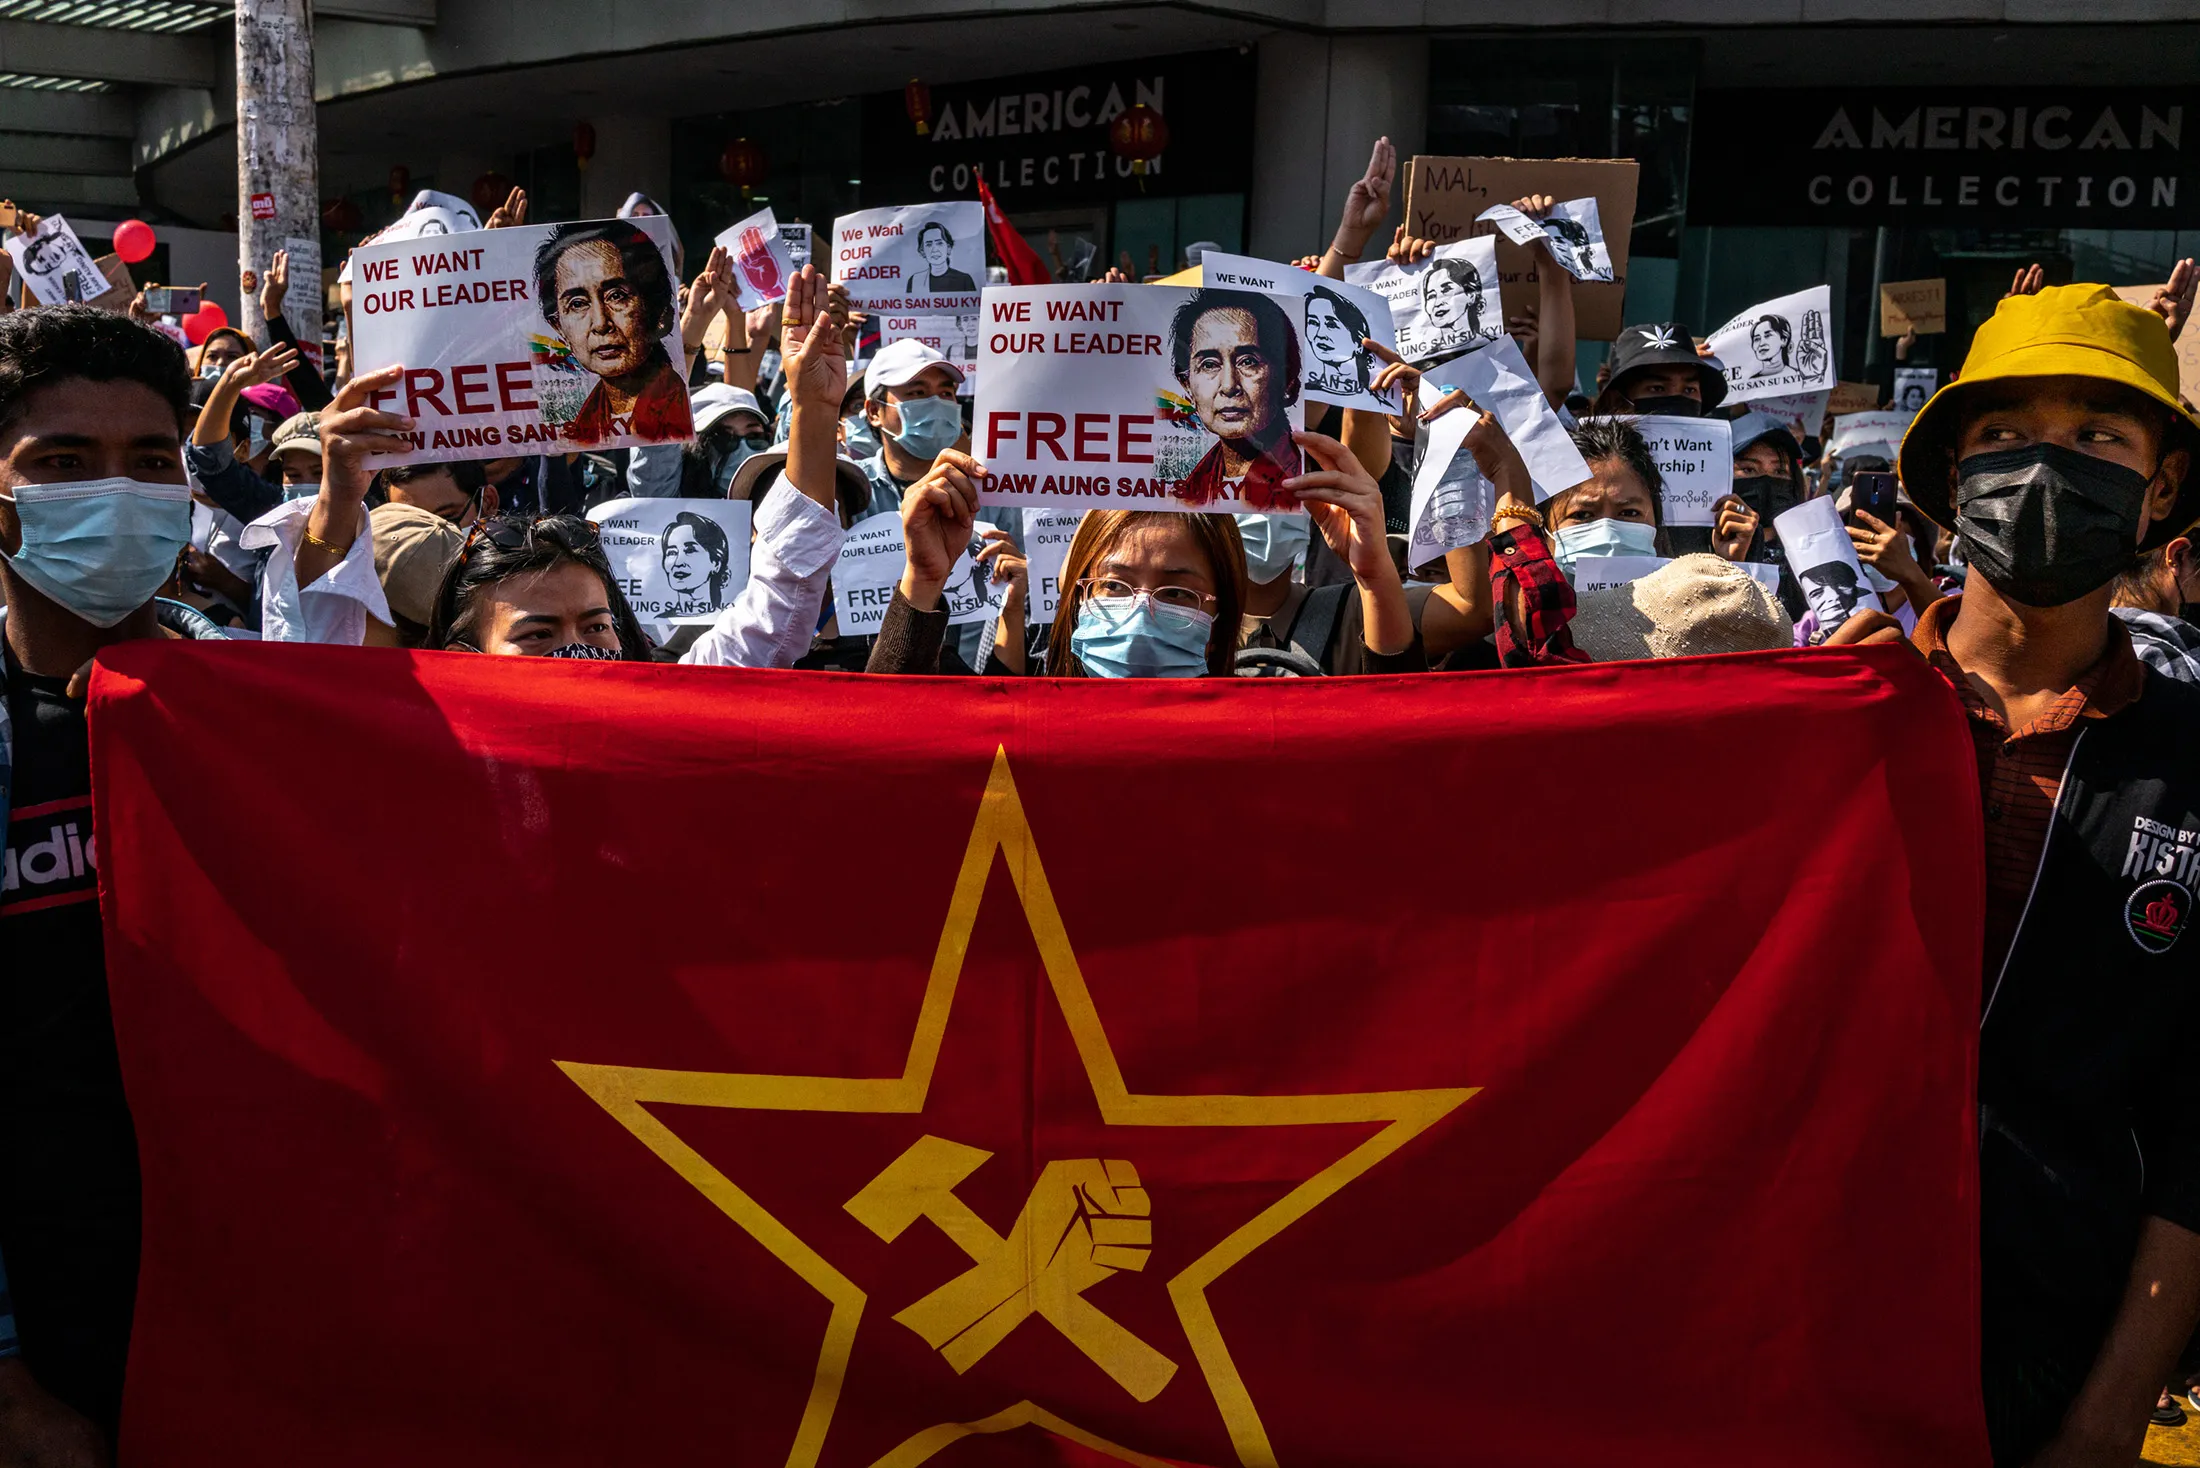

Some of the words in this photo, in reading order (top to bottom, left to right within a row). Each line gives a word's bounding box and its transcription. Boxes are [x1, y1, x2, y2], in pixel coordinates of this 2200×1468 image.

[932, 76, 1165, 142] AMERICAN
[1812, 105, 2184, 151] AMERICAN
[1425, 166, 1487, 197] MAL,
[1808, 175, 2178, 208] COLLECTION
[842, 229, 863, 242] We
[868, 223, 904, 239] Want
[1418, 210, 1464, 239] Your
[840, 247, 872, 261] OUR
[363, 259, 399, 283] WE
[412, 248, 485, 276] WANT
[839, 266, 901, 281] LEADER
[1216, 272, 1237, 285] WE
[1239, 276, 1275, 290] WANT
[1376, 278, 1404, 290] WANT
[364, 289, 415, 315] OUR
[423, 279, 529, 308] LEADER
[1387, 288, 1419, 302] EADER
[868, 299, 902, 310] AUNG
[905, 299, 931, 309] SAN
[934, 298, 958, 308] SUU
[992, 302, 1031, 323] WE
[1046, 301, 1124, 322] WANT
[888, 319, 917, 330] OUR
[990, 333, 1045, 354] OUR
[1053, 333, 1163, 356] LEADER
[1431, 335, 1456, 350] SAN
[1308, 371, 1340, 390] SAN
[1746, 381, 1766, 390] SAN
[1768, 377, 1781, 386] SU
[432, 426, 501, 450] AUNG
[507, 422, 557, 444] SAN
[986, 412, 1154, 464] FREE
[1673, 439, 1713, 452] Want
[982, 473, 1037, 494] DAW
[1041, 475, 1110, 496] AUNG
[1116, 477, 1166, 498] SAN
[608, 519, 640, 529] WANT
[1037, 517, 1054, 527] WE
[613, 536, 655, 546] LEADER
[860, 529, 892, 541] WANT
[1037, 534, 1062, 545] OUR
[842, 548, 866, 559] OUR
[868, 543, 906, 556] LEADE
[848, 586, 895, 608] FRE
[631, 601, 660, 613] UNG
[664, 601, 694, 614] SAN
[851, 609, 883, 624] DAW
[2134, 816, 2177, 841] DESIGN
[2177, 829, 2197, 844] BY
